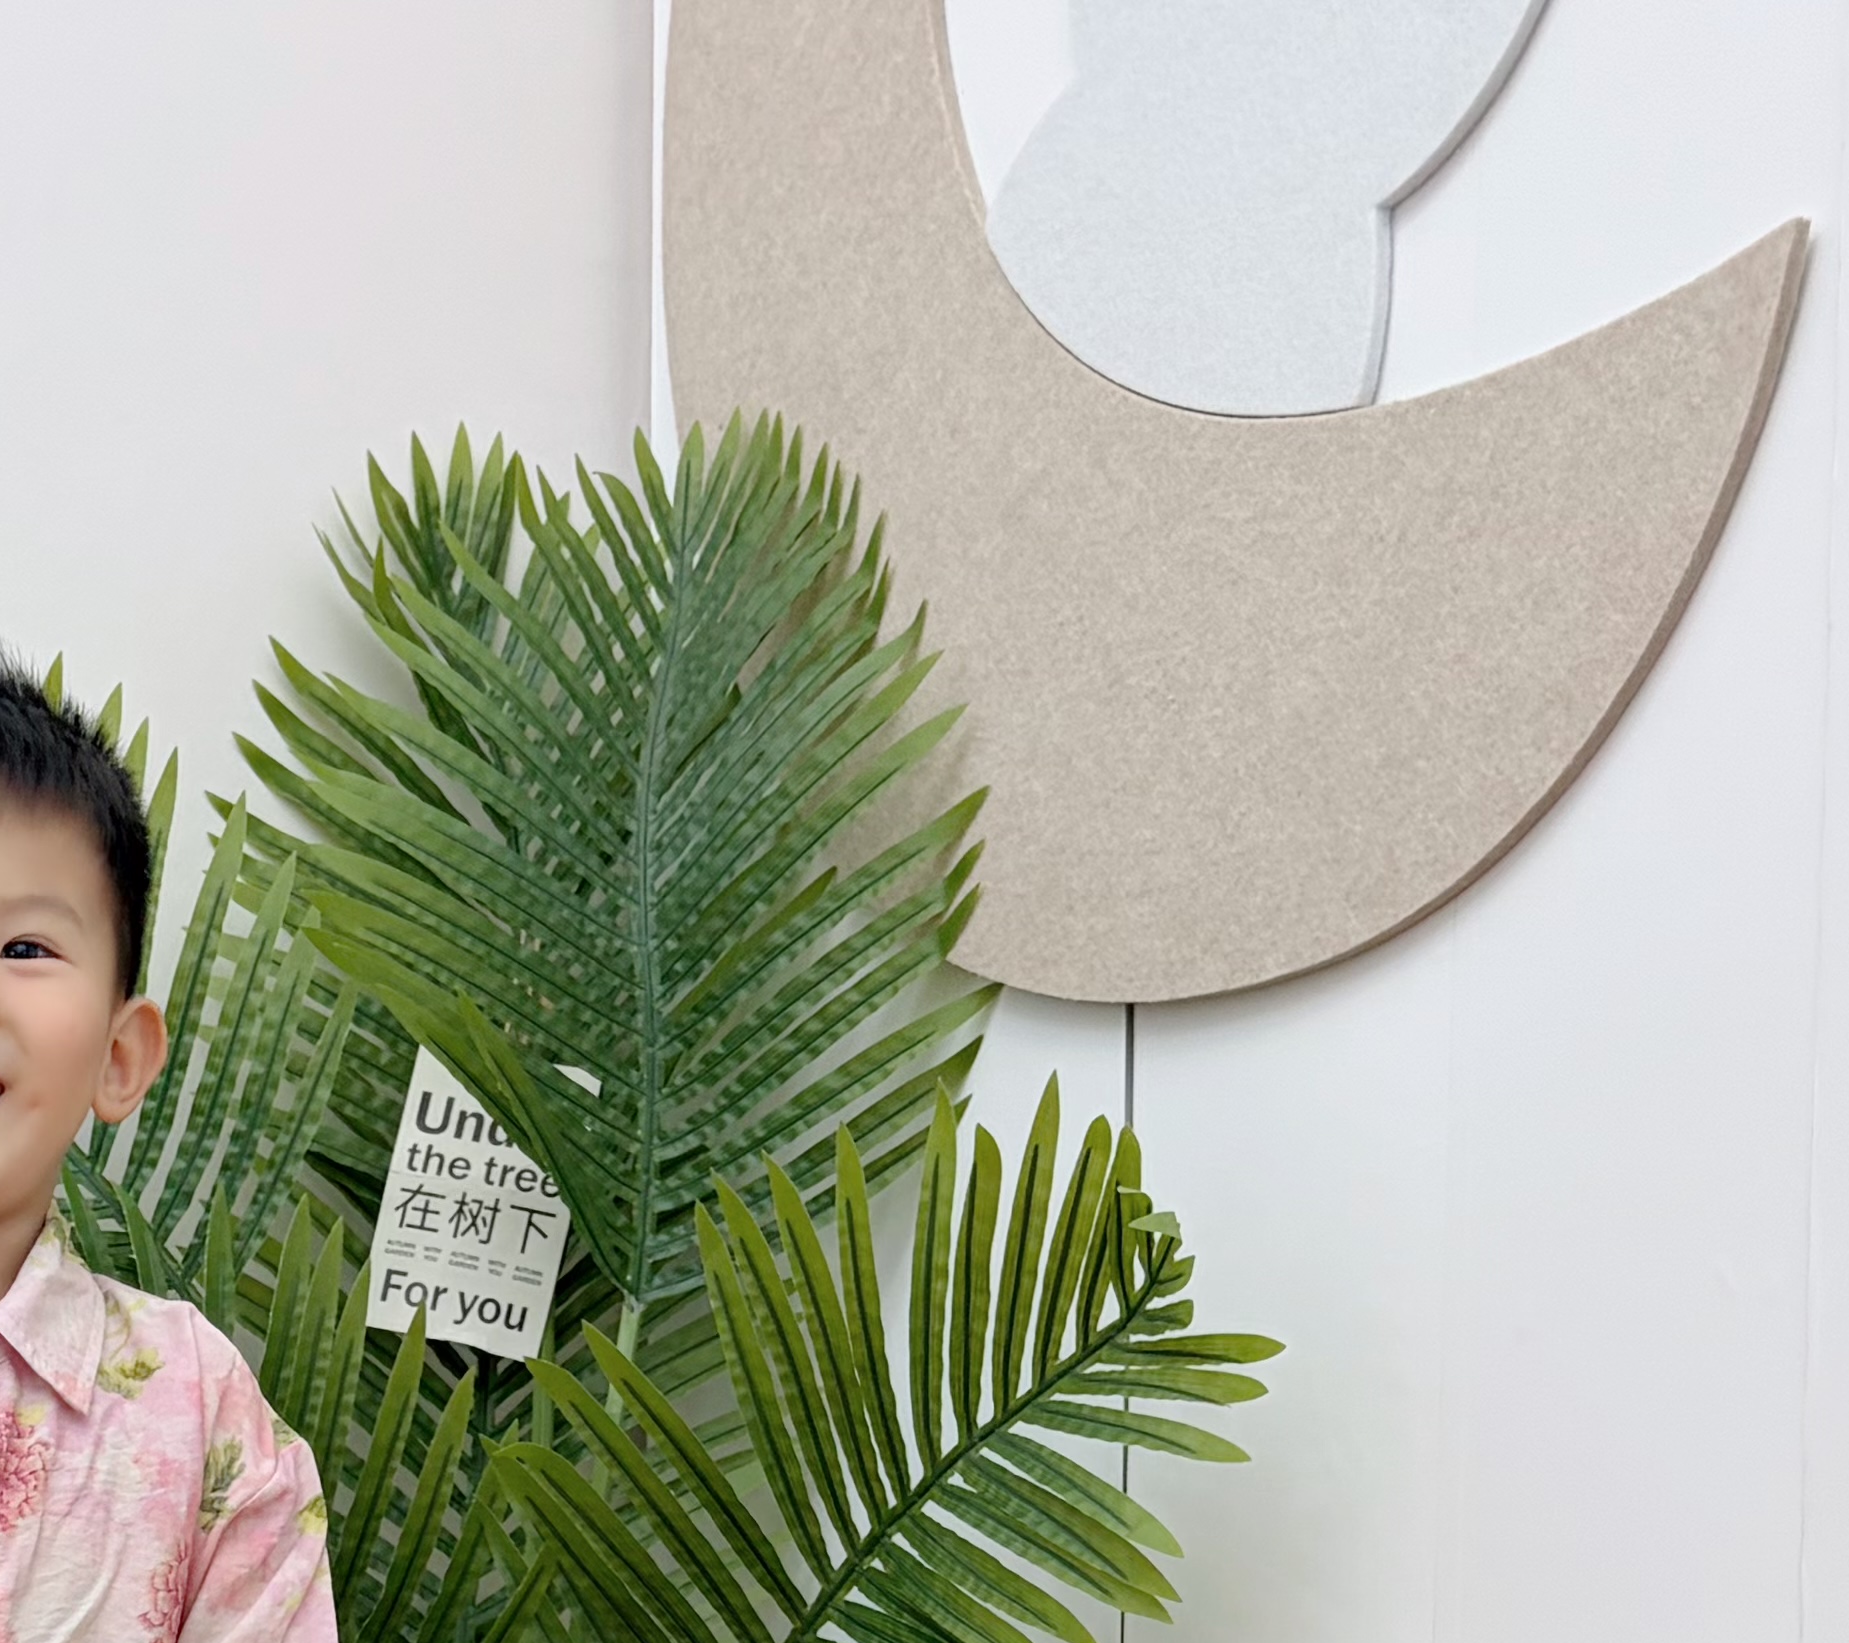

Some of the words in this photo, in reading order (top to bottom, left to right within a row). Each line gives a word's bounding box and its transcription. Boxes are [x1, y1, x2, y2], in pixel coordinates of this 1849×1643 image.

[406, 1143, 472, 1180] the
[483, 1156, 560, 1198] tree
[393, 1183, 557, 1254] 在树下
[380, 1268, 448, 1311] For
[453, 1289, 528, 1332] you
